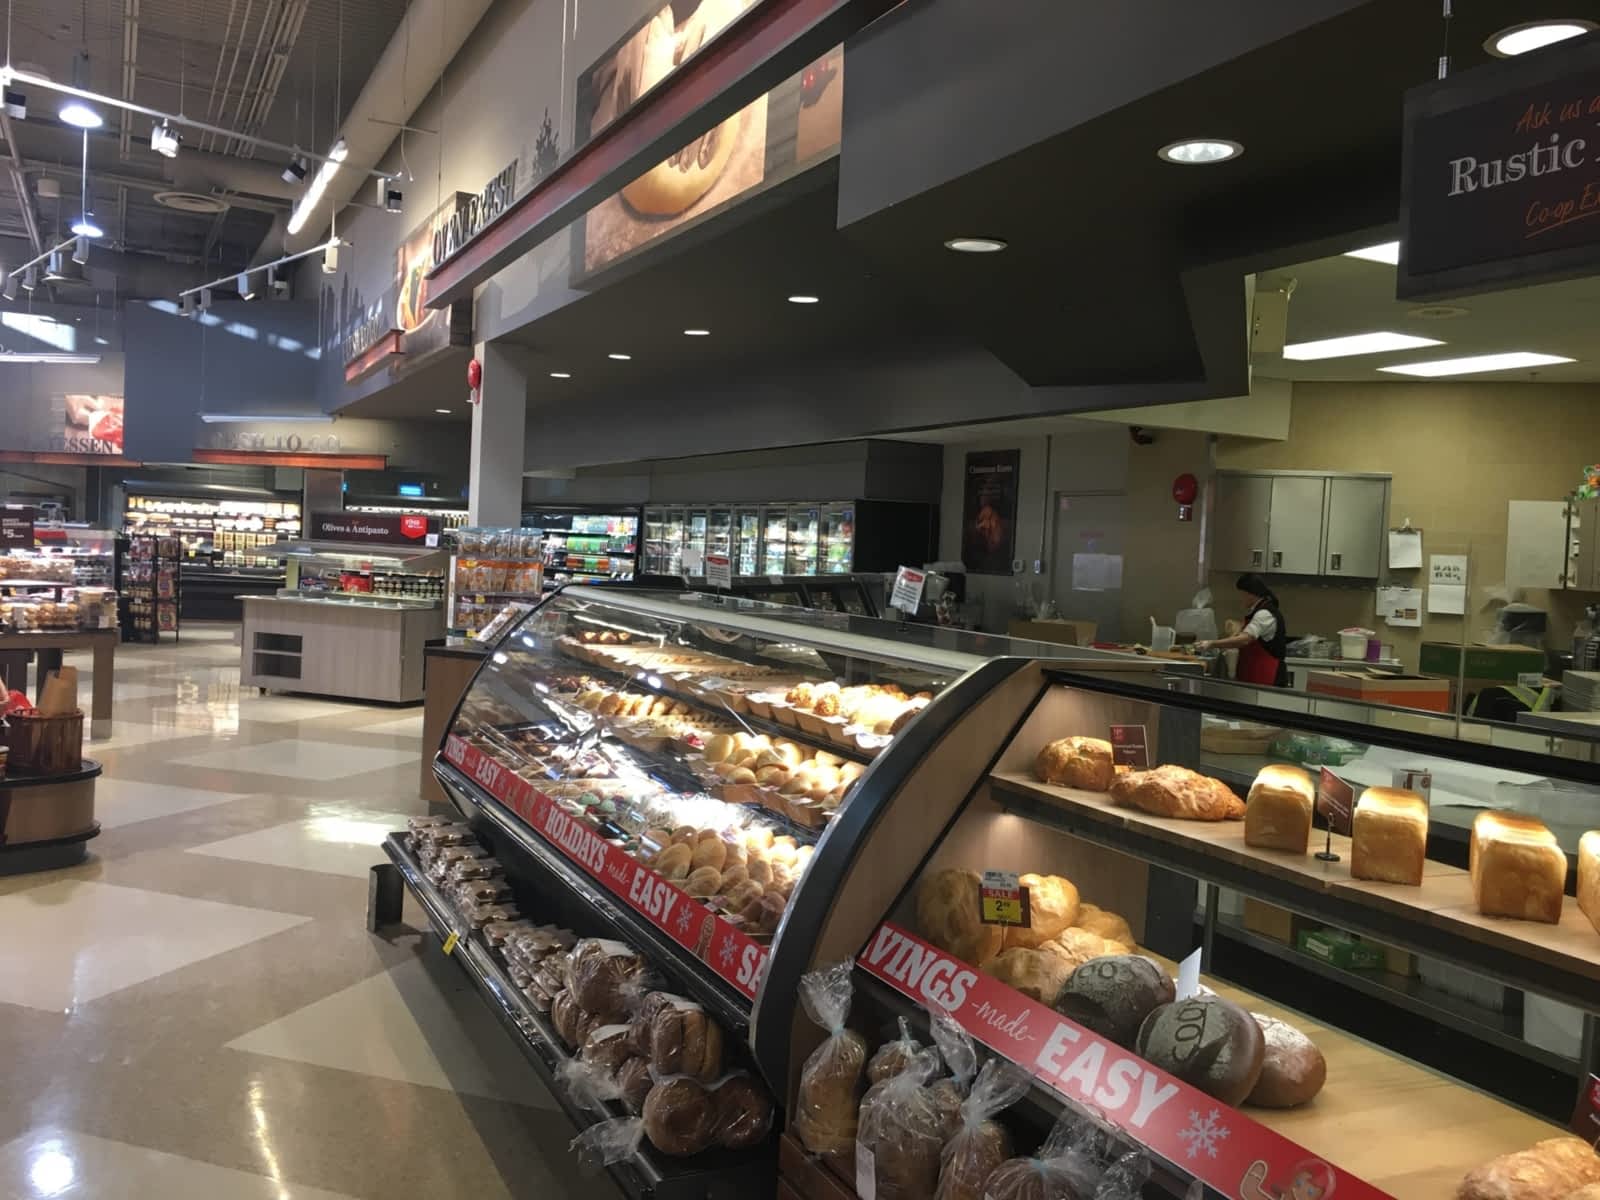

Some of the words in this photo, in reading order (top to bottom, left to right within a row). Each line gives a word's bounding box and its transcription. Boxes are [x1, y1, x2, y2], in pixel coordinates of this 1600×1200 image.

[1515, 101, 1551, 134] Ask
[1560, 99, 1583, 121] us
[1448, 133, 1586, 197] Rustic
[322, 522, 345, 533] Olives
[352, 525, 389, 536] Antipasto
[475, 755, 501, 790] EASY
[545, 808, 609, 873] HOLIDAYS
[629, 867, 678, 924] EASY
[1035, 1022, 1179, 1129] EASY
